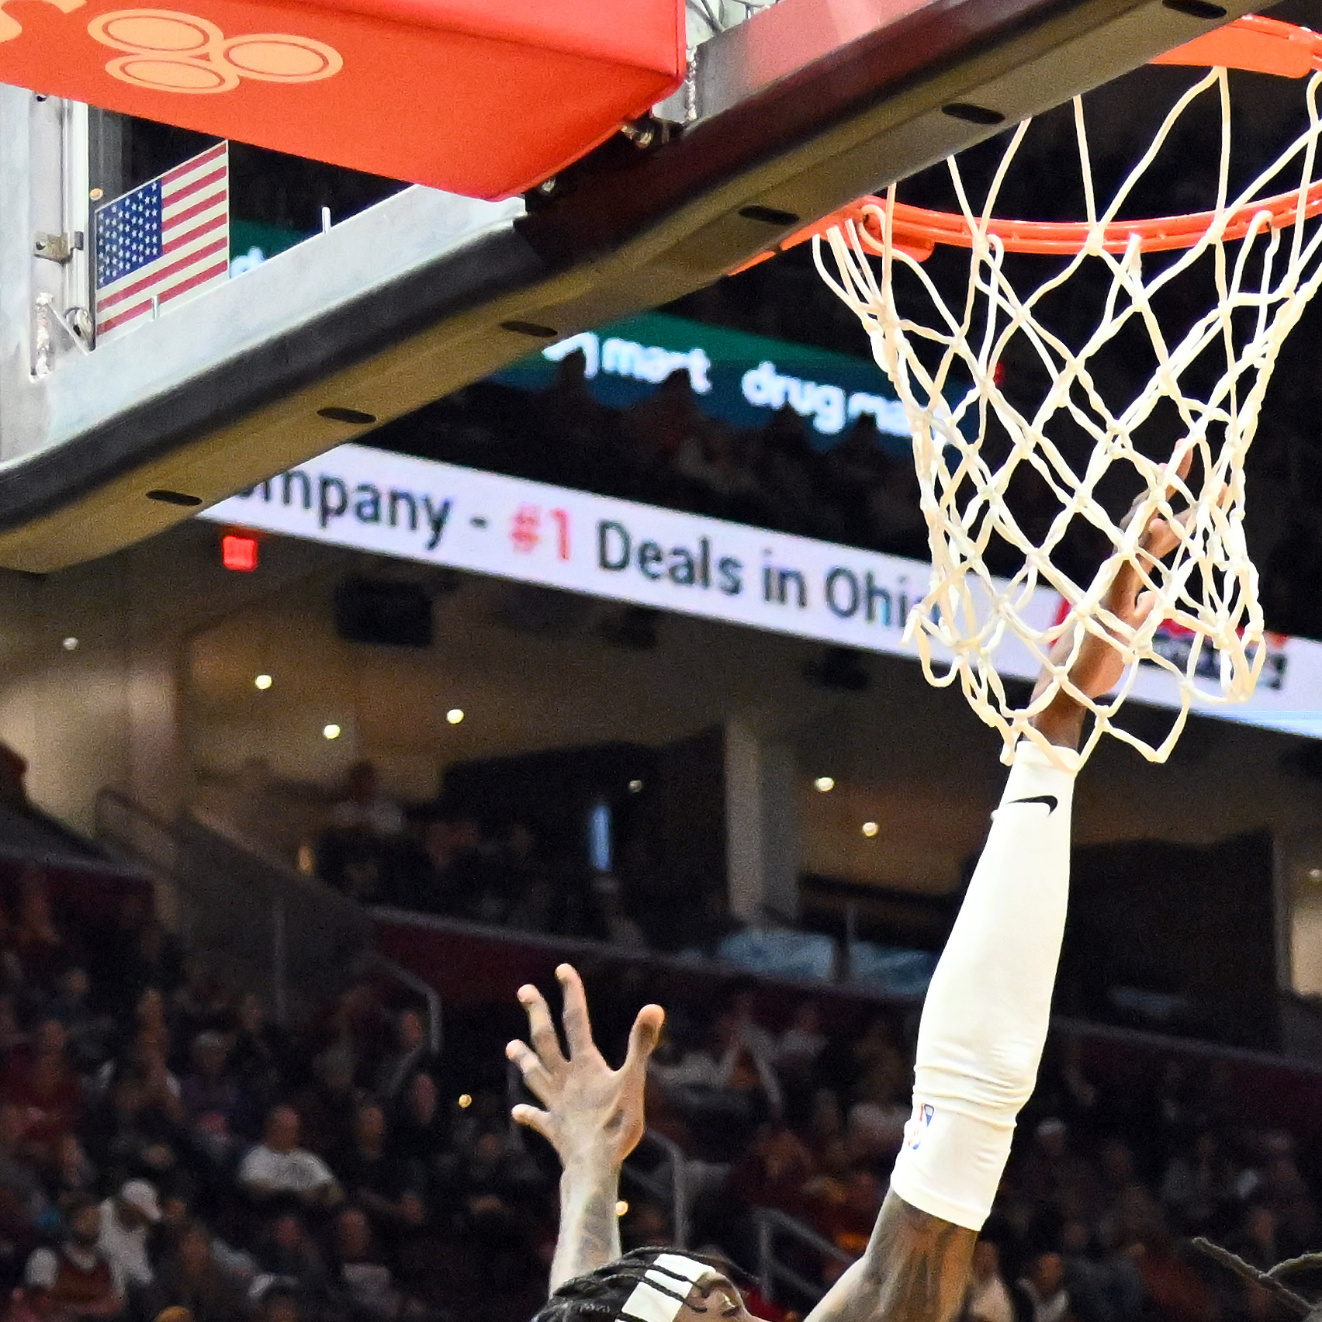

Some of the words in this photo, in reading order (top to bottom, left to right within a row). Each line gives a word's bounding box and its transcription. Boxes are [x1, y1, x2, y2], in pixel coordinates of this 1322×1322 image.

[740, 361, 846, 434] drug
[238, 469, 453, 550] mpany
[510, 503, 571, 561] #1
[596, 518, 742, 596] Deals
[763, 548, 807, 609] in
